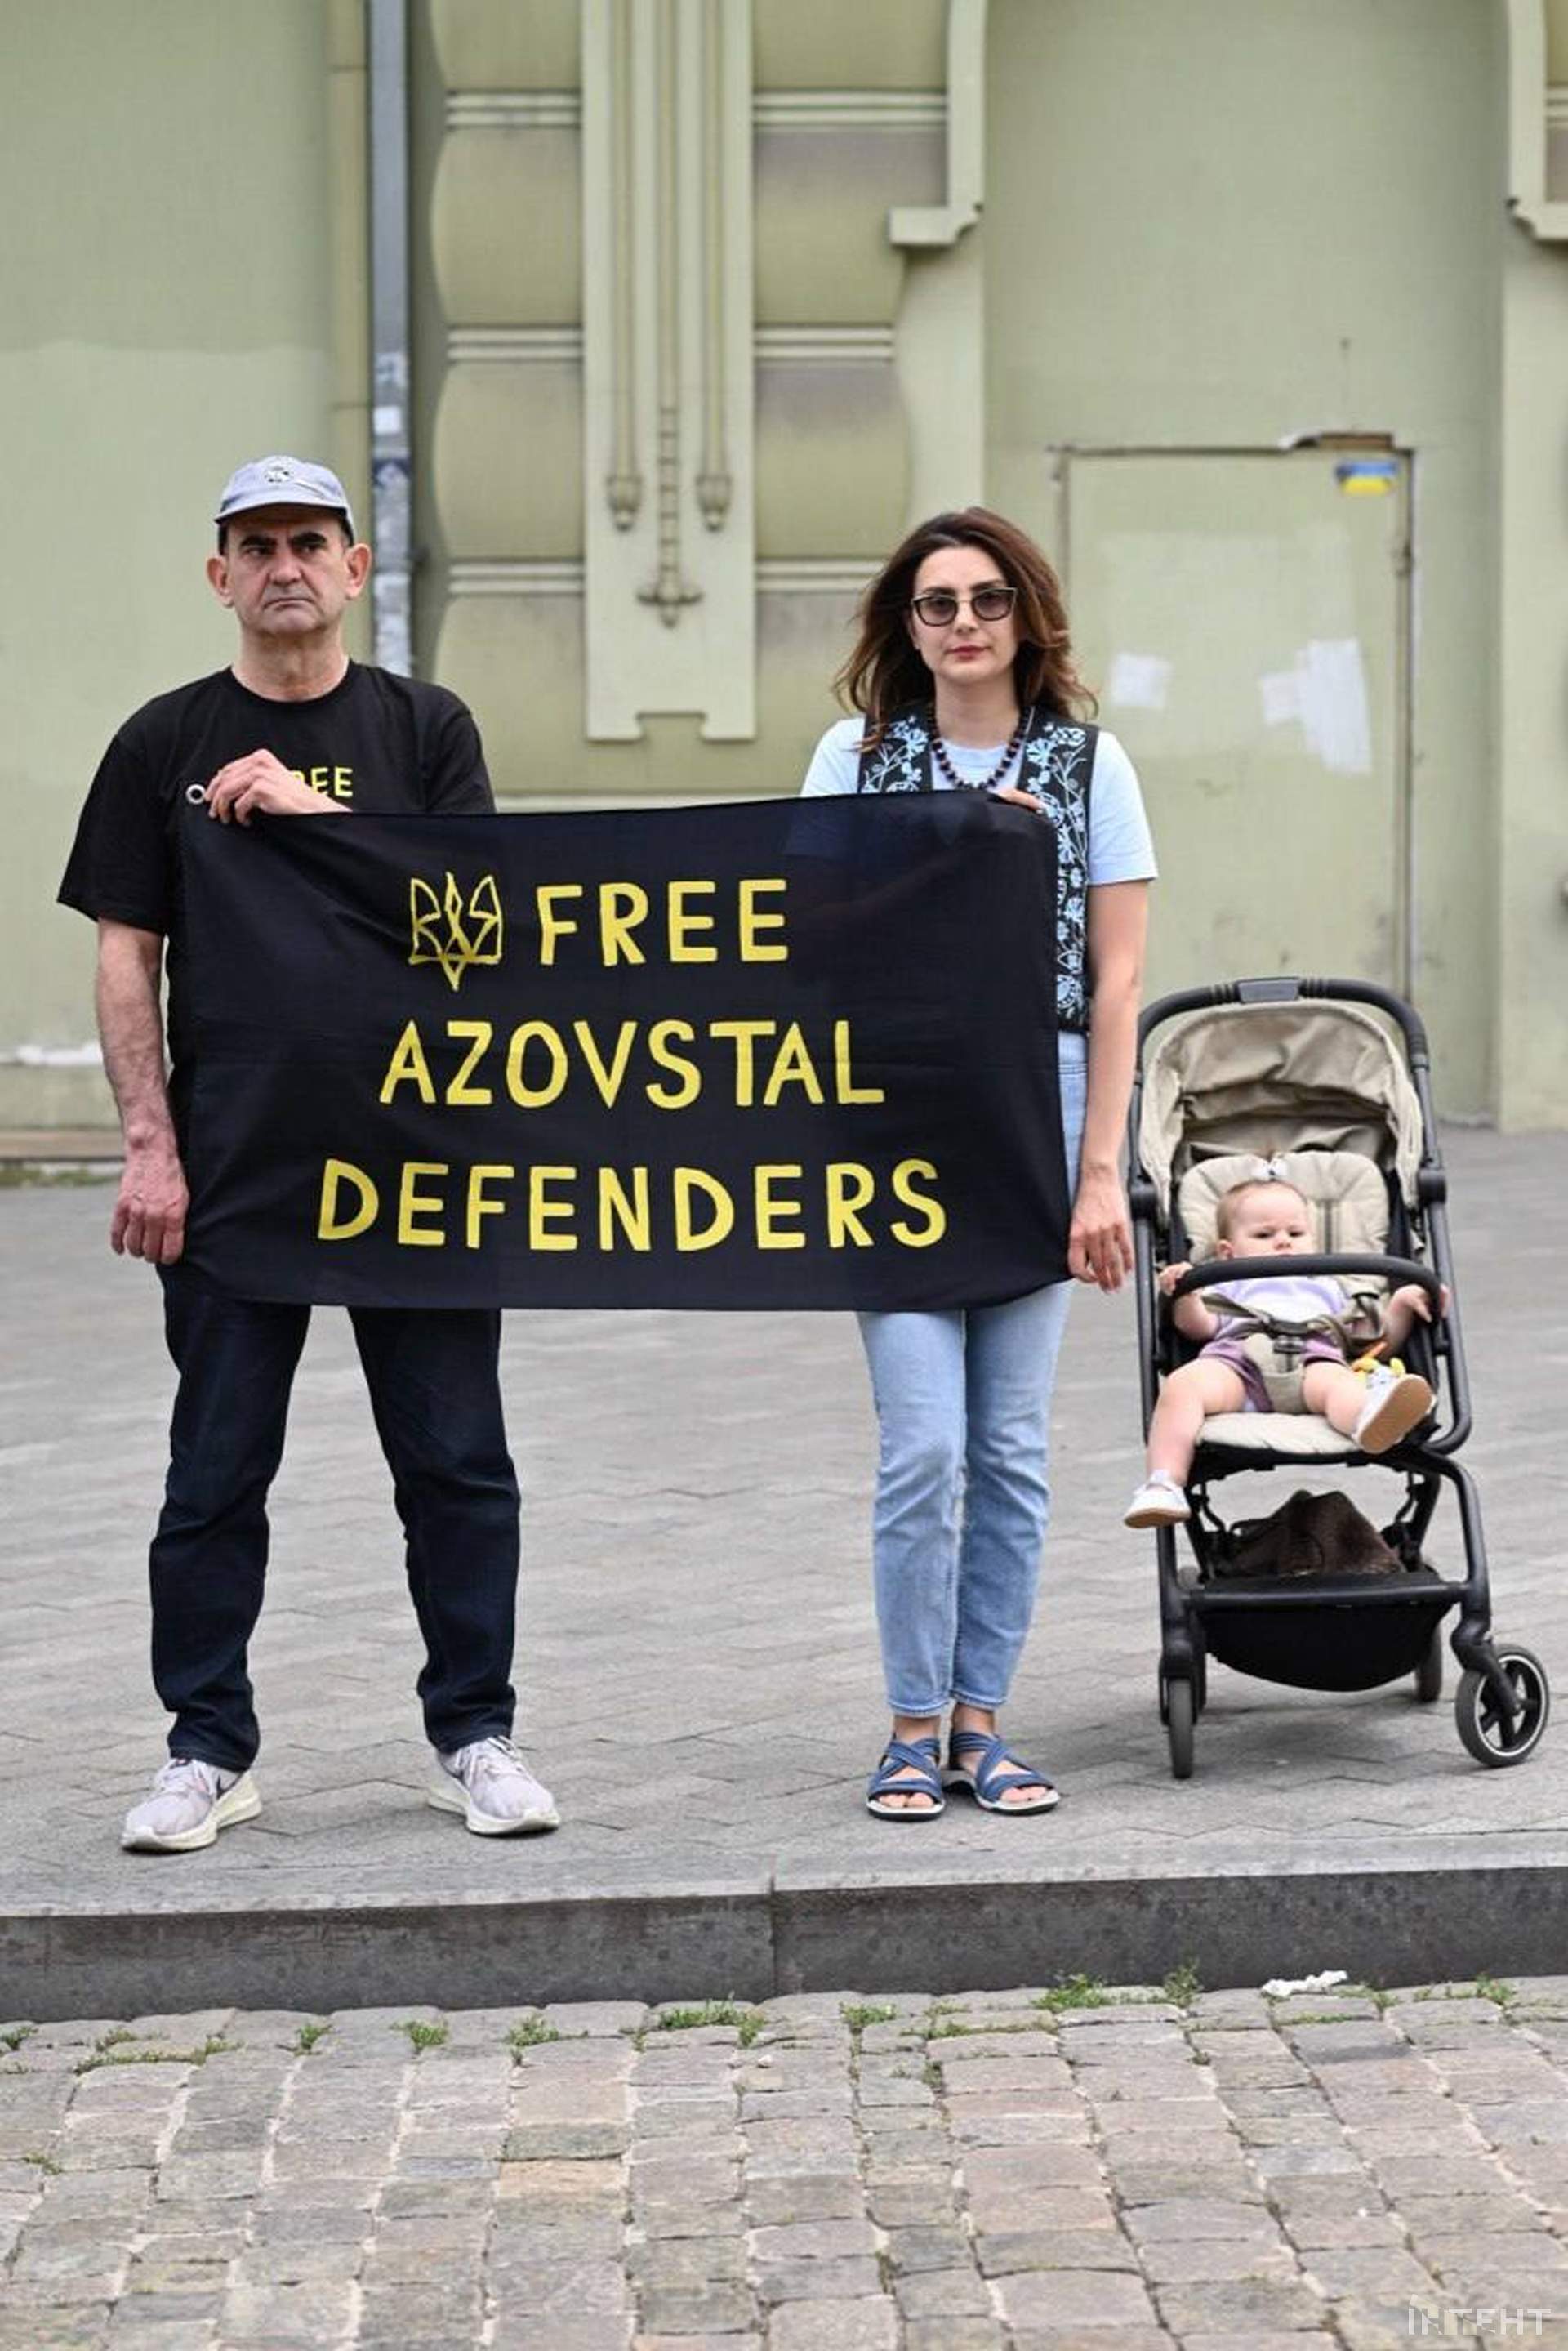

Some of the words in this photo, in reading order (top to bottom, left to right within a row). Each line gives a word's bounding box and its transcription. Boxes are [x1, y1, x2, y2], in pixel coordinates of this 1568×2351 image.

[291, 766, 354, 797] EE
[536, 878, 790, 966] FREE
[381, 1019, 884, 1109] AZOVSTAL
[318, 1158, 947, 1252] DEFENDERS
